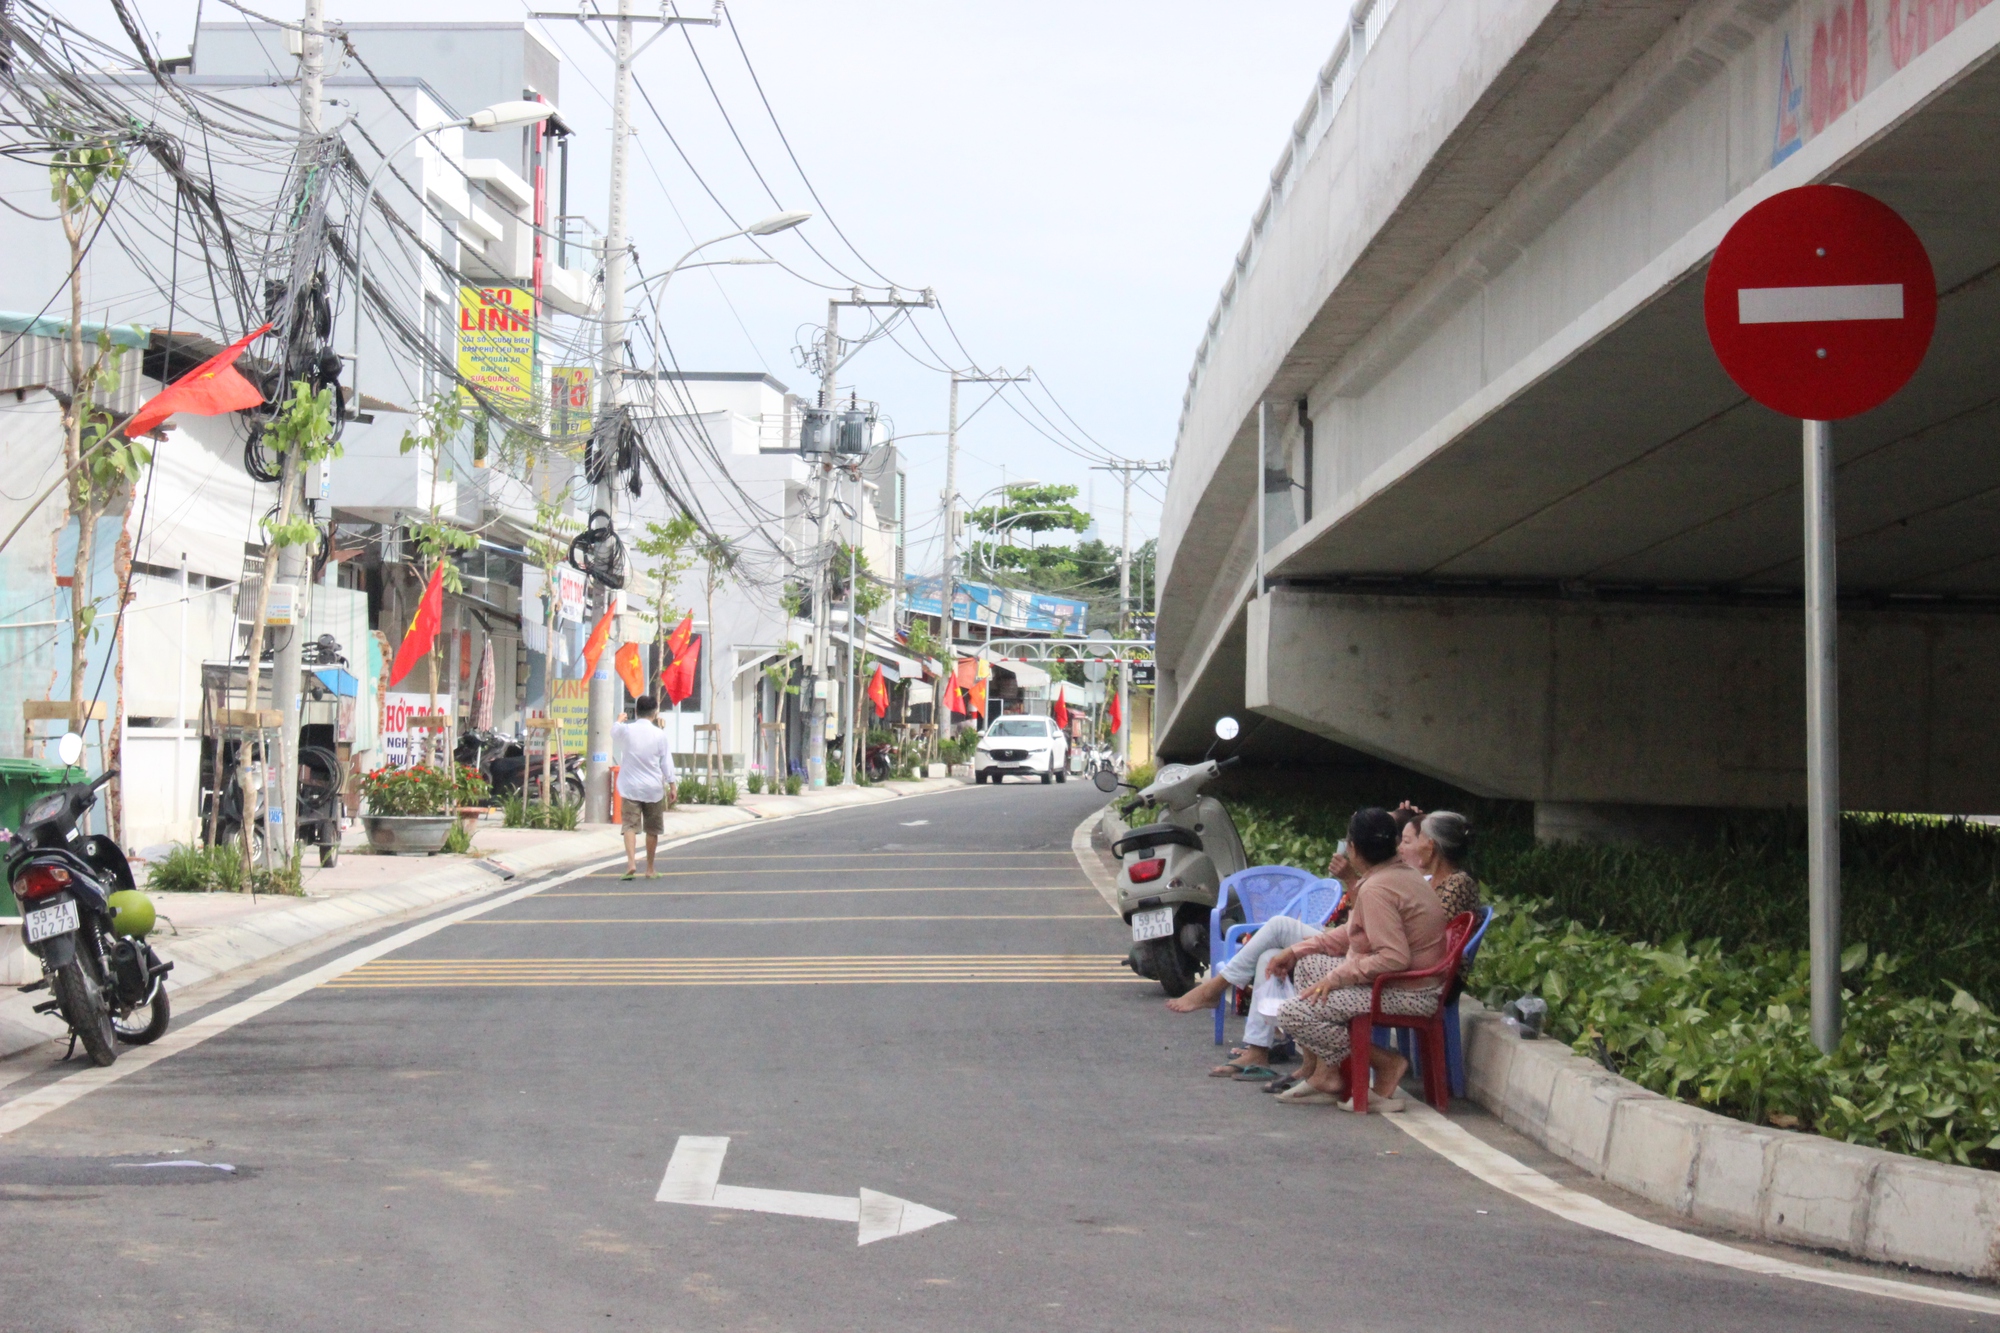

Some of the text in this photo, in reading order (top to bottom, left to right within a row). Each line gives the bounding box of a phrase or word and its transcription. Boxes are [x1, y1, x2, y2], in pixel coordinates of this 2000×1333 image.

[461, 308, 530, 331] LINH
[33, 904, 69, 925] 59-ZA
[1138, 911, 1166, 926] 59-C2
[31, 916, 75, 940] 042.73
[1136, 923, 1171, 941] 122.10
